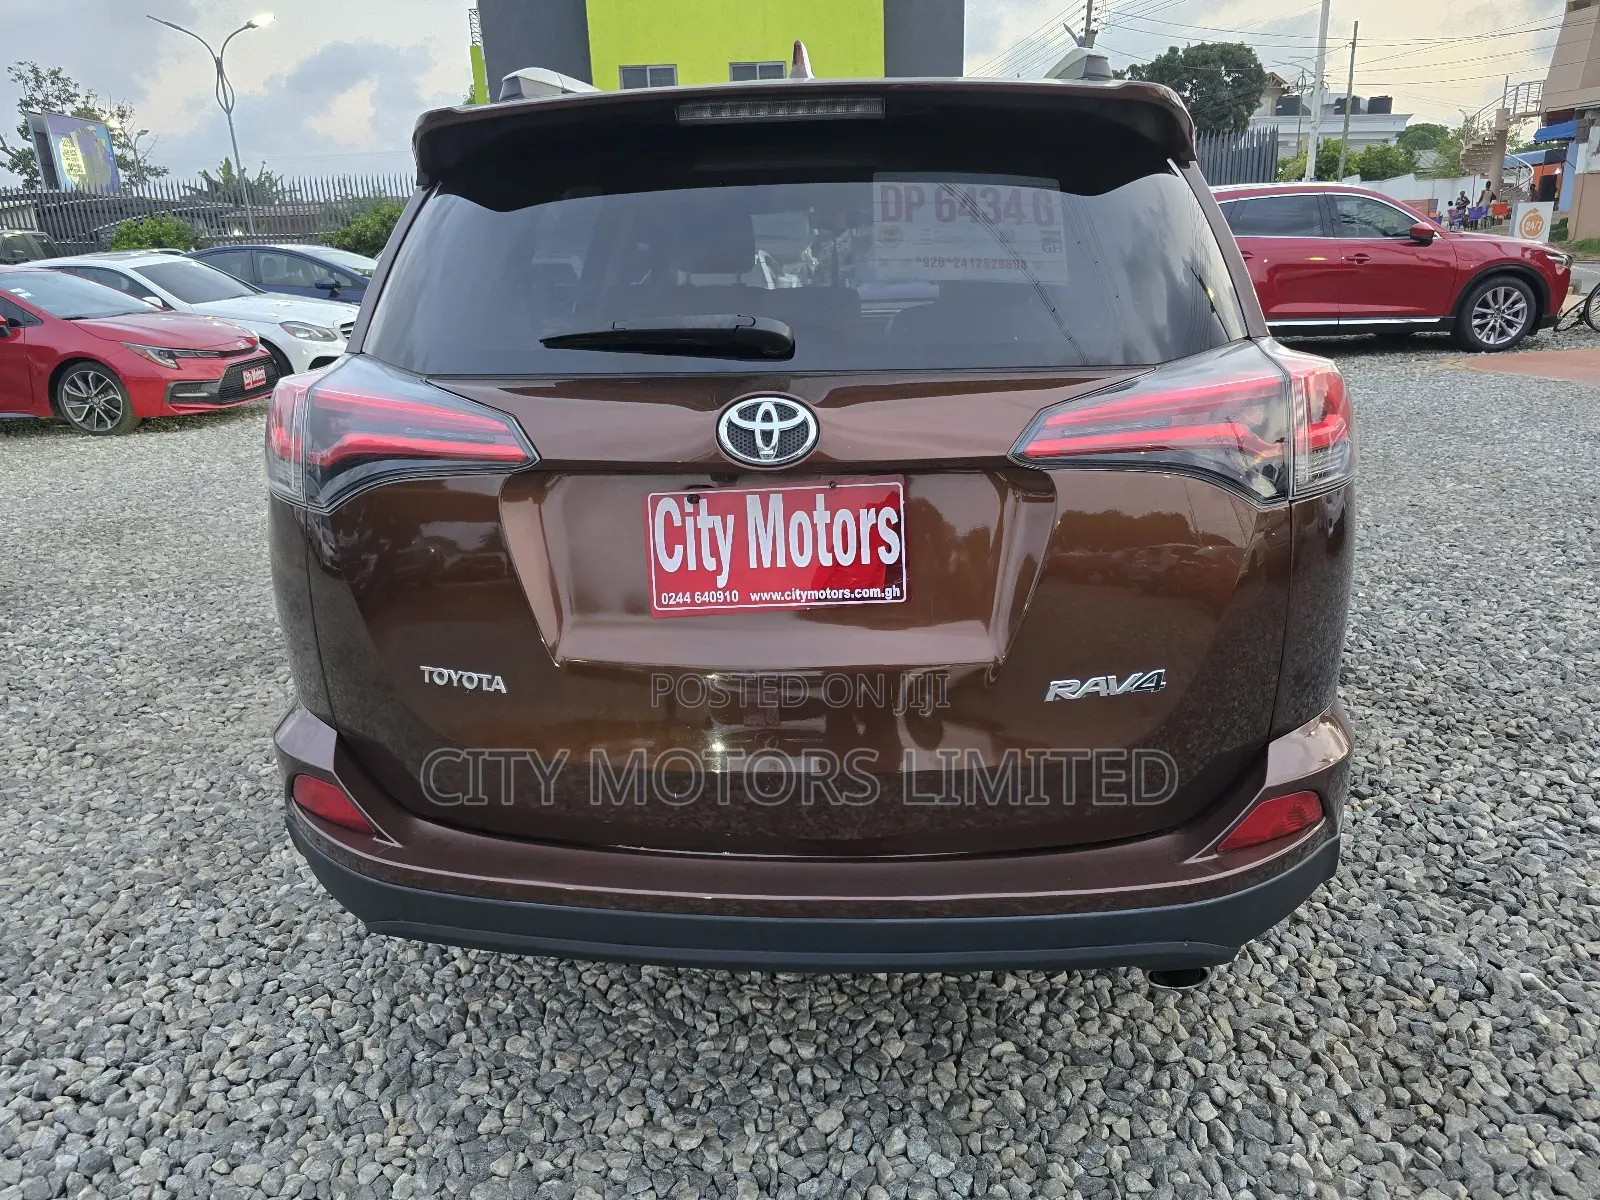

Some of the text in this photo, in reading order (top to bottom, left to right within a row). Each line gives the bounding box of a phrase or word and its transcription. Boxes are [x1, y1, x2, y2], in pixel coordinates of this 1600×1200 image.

[880, 184, 1055, 227] DP 6434 G
[1525, 221, 1543, 231] 24/7
[1041, 243, 1063, 254] GH
[654, 493, 901, 589] City Motors
[661, 586, 901, 605] 0244 640910 www.citymotors.com.gh
[419, 665, 507, 694] TOYOTA
[1044, 669, 1166, 702] RAV4
